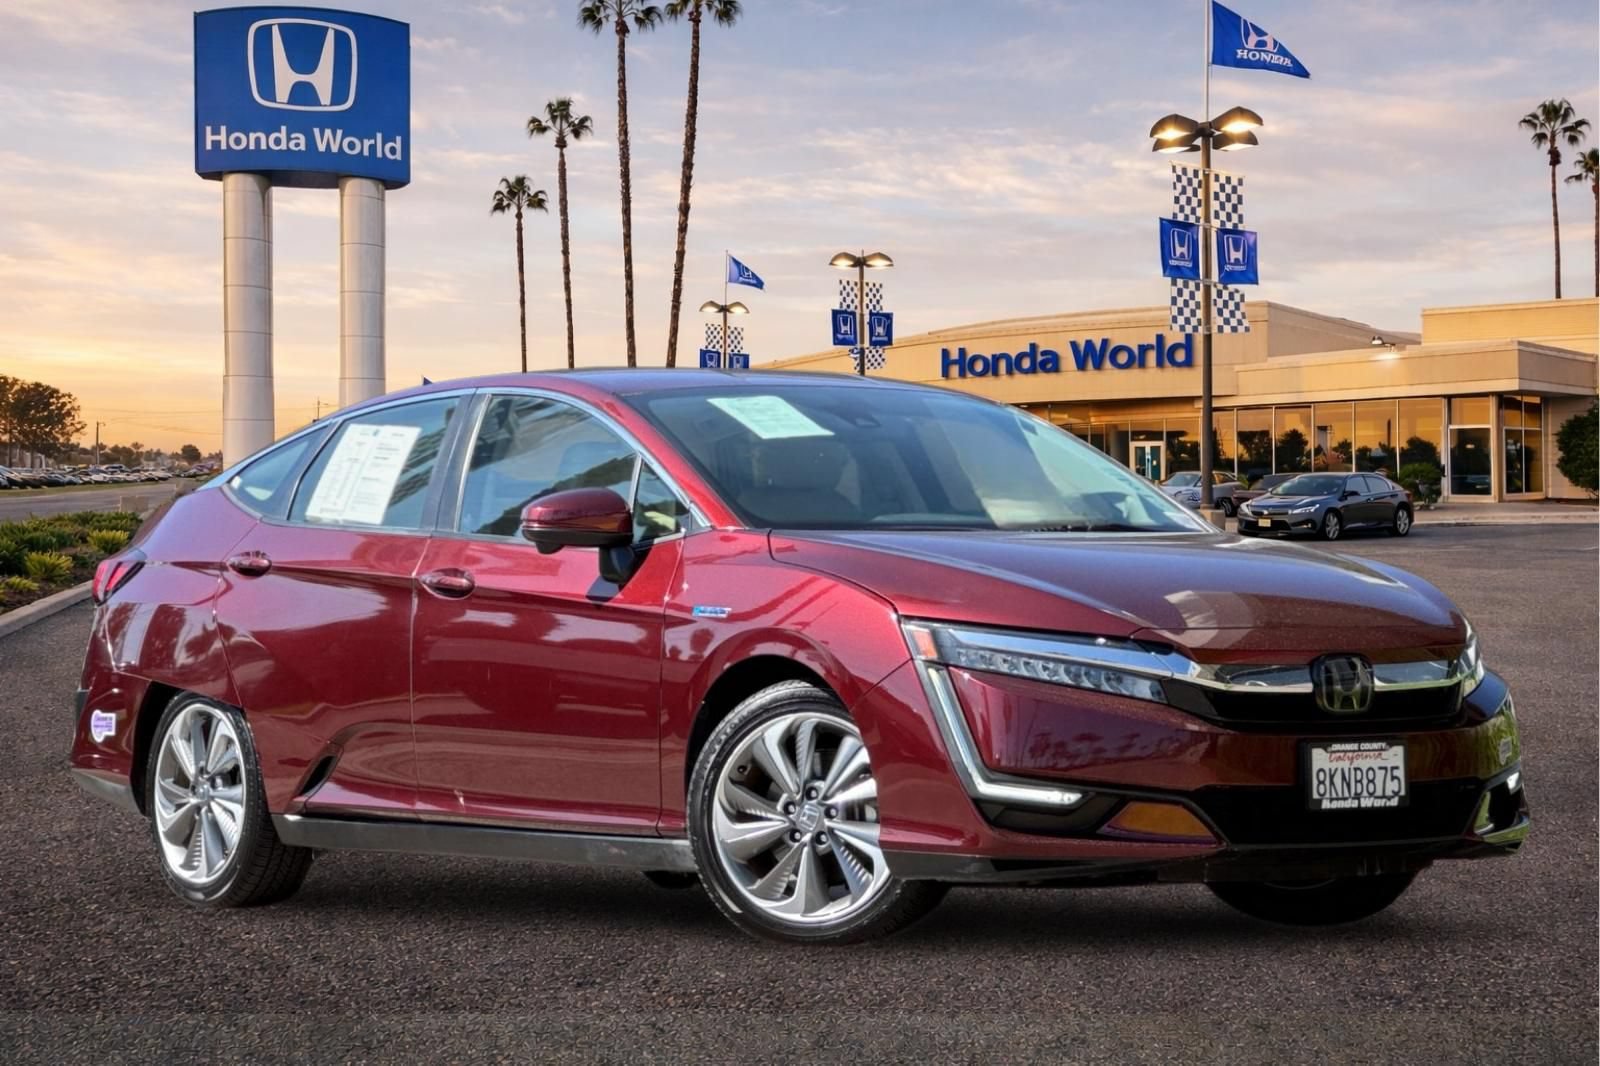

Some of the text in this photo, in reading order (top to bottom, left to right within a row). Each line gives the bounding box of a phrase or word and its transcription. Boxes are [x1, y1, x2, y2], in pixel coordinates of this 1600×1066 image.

[205, 125, 402, 161] Honda World
[941, 333, 1194, 378] Honda World
[1331, 742, 1387, 751] ORANGE COUNTY
[1328, 751, 1385, 766] California
[1316, 766, 1402, 798] 8KNB875
[1321, 796, 1399, 809] Honda World
